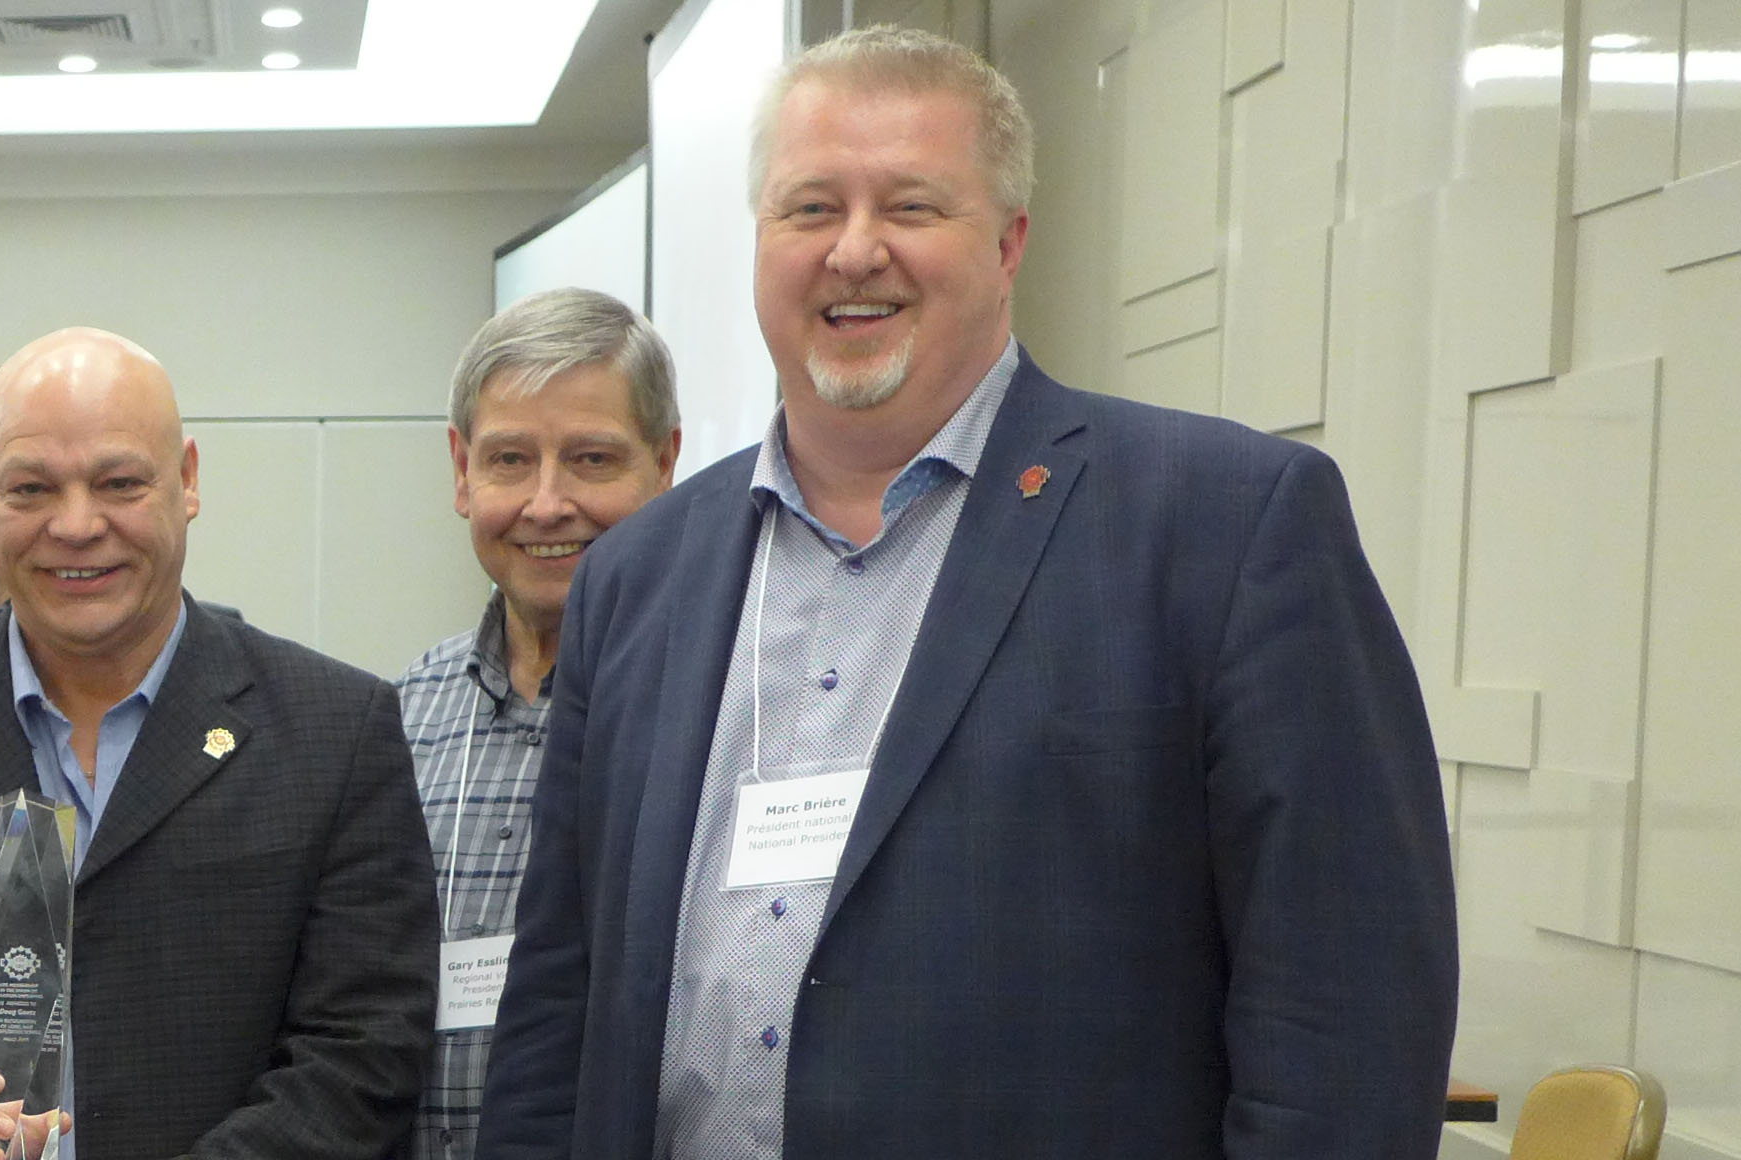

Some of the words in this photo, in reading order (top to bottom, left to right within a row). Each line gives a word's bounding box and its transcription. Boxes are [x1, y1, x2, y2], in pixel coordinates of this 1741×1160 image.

[765, 804, 799, 816] Marc
[803, 797, 847, 811] Brière
[747, 820, 800, 834] Président
[804, 813, 852, 827] national
[748, 837, 796, 850] National
[447, 961, 473, 971] Gary
[453, 972, 493, 984] Regional
[448, 1000, 482, 1009] Prairies
